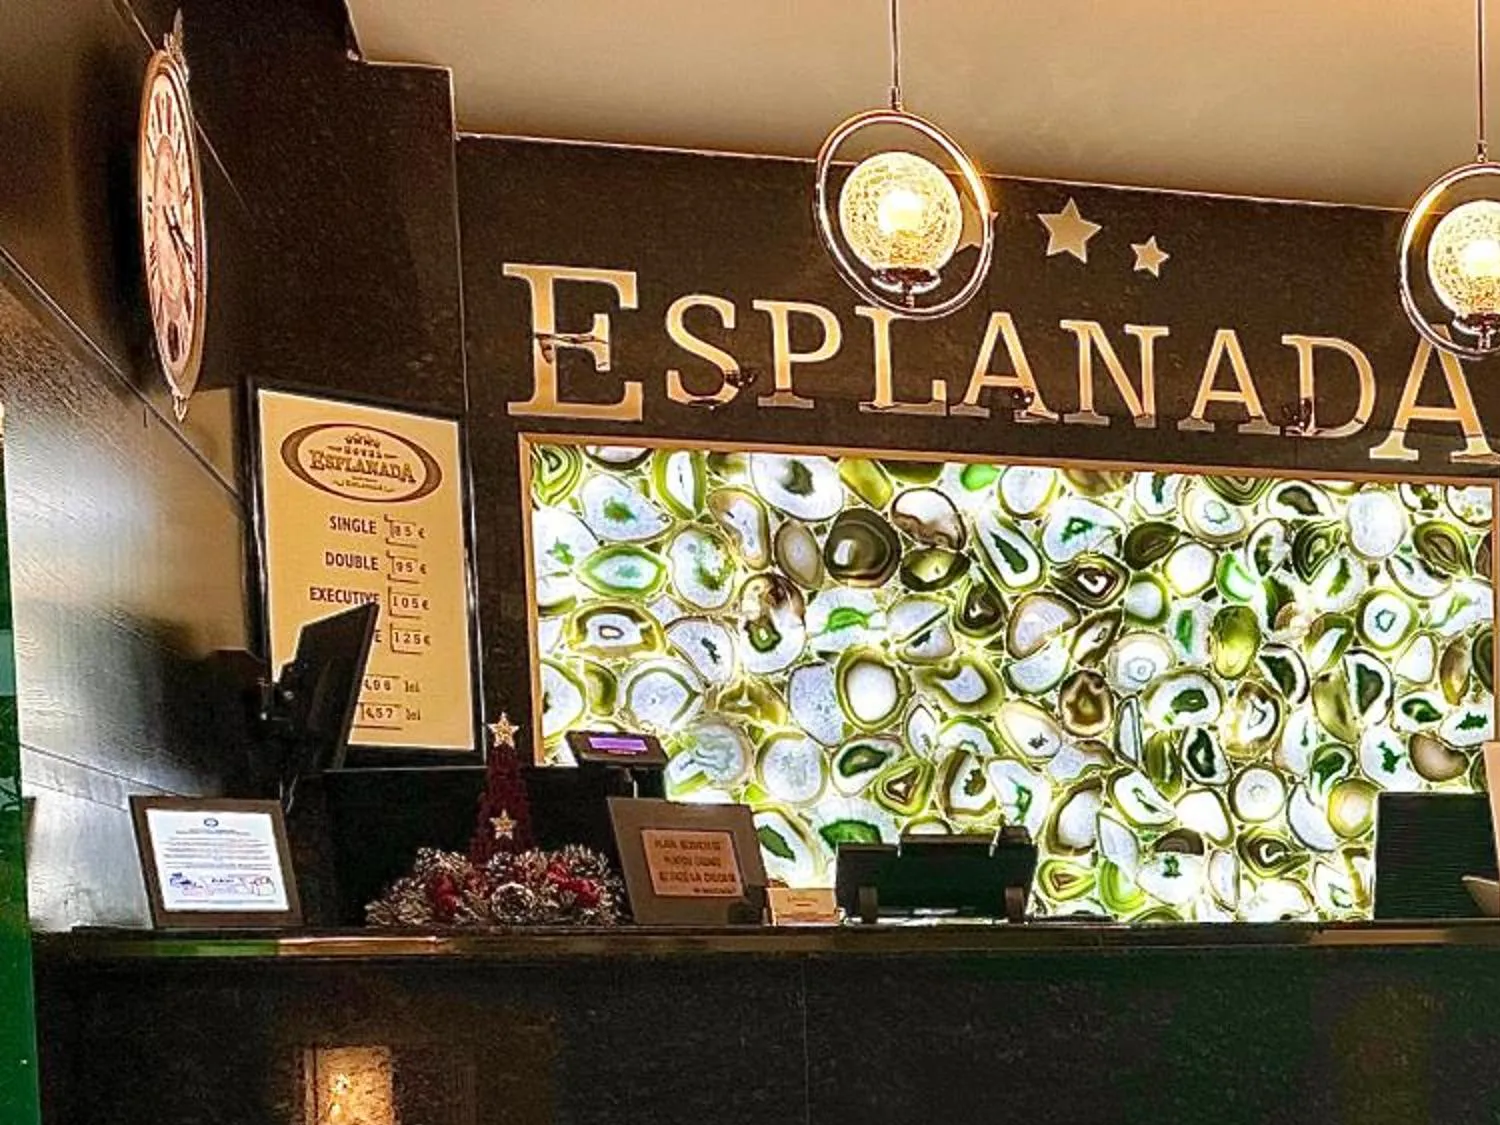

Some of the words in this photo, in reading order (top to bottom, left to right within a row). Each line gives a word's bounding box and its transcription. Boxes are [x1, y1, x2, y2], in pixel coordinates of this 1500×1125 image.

[308, 449, 417, 484] ESPLANADA
[328, 516, 377, 535] SINGLE
[325, 552, 380, 571] DOUBLE
